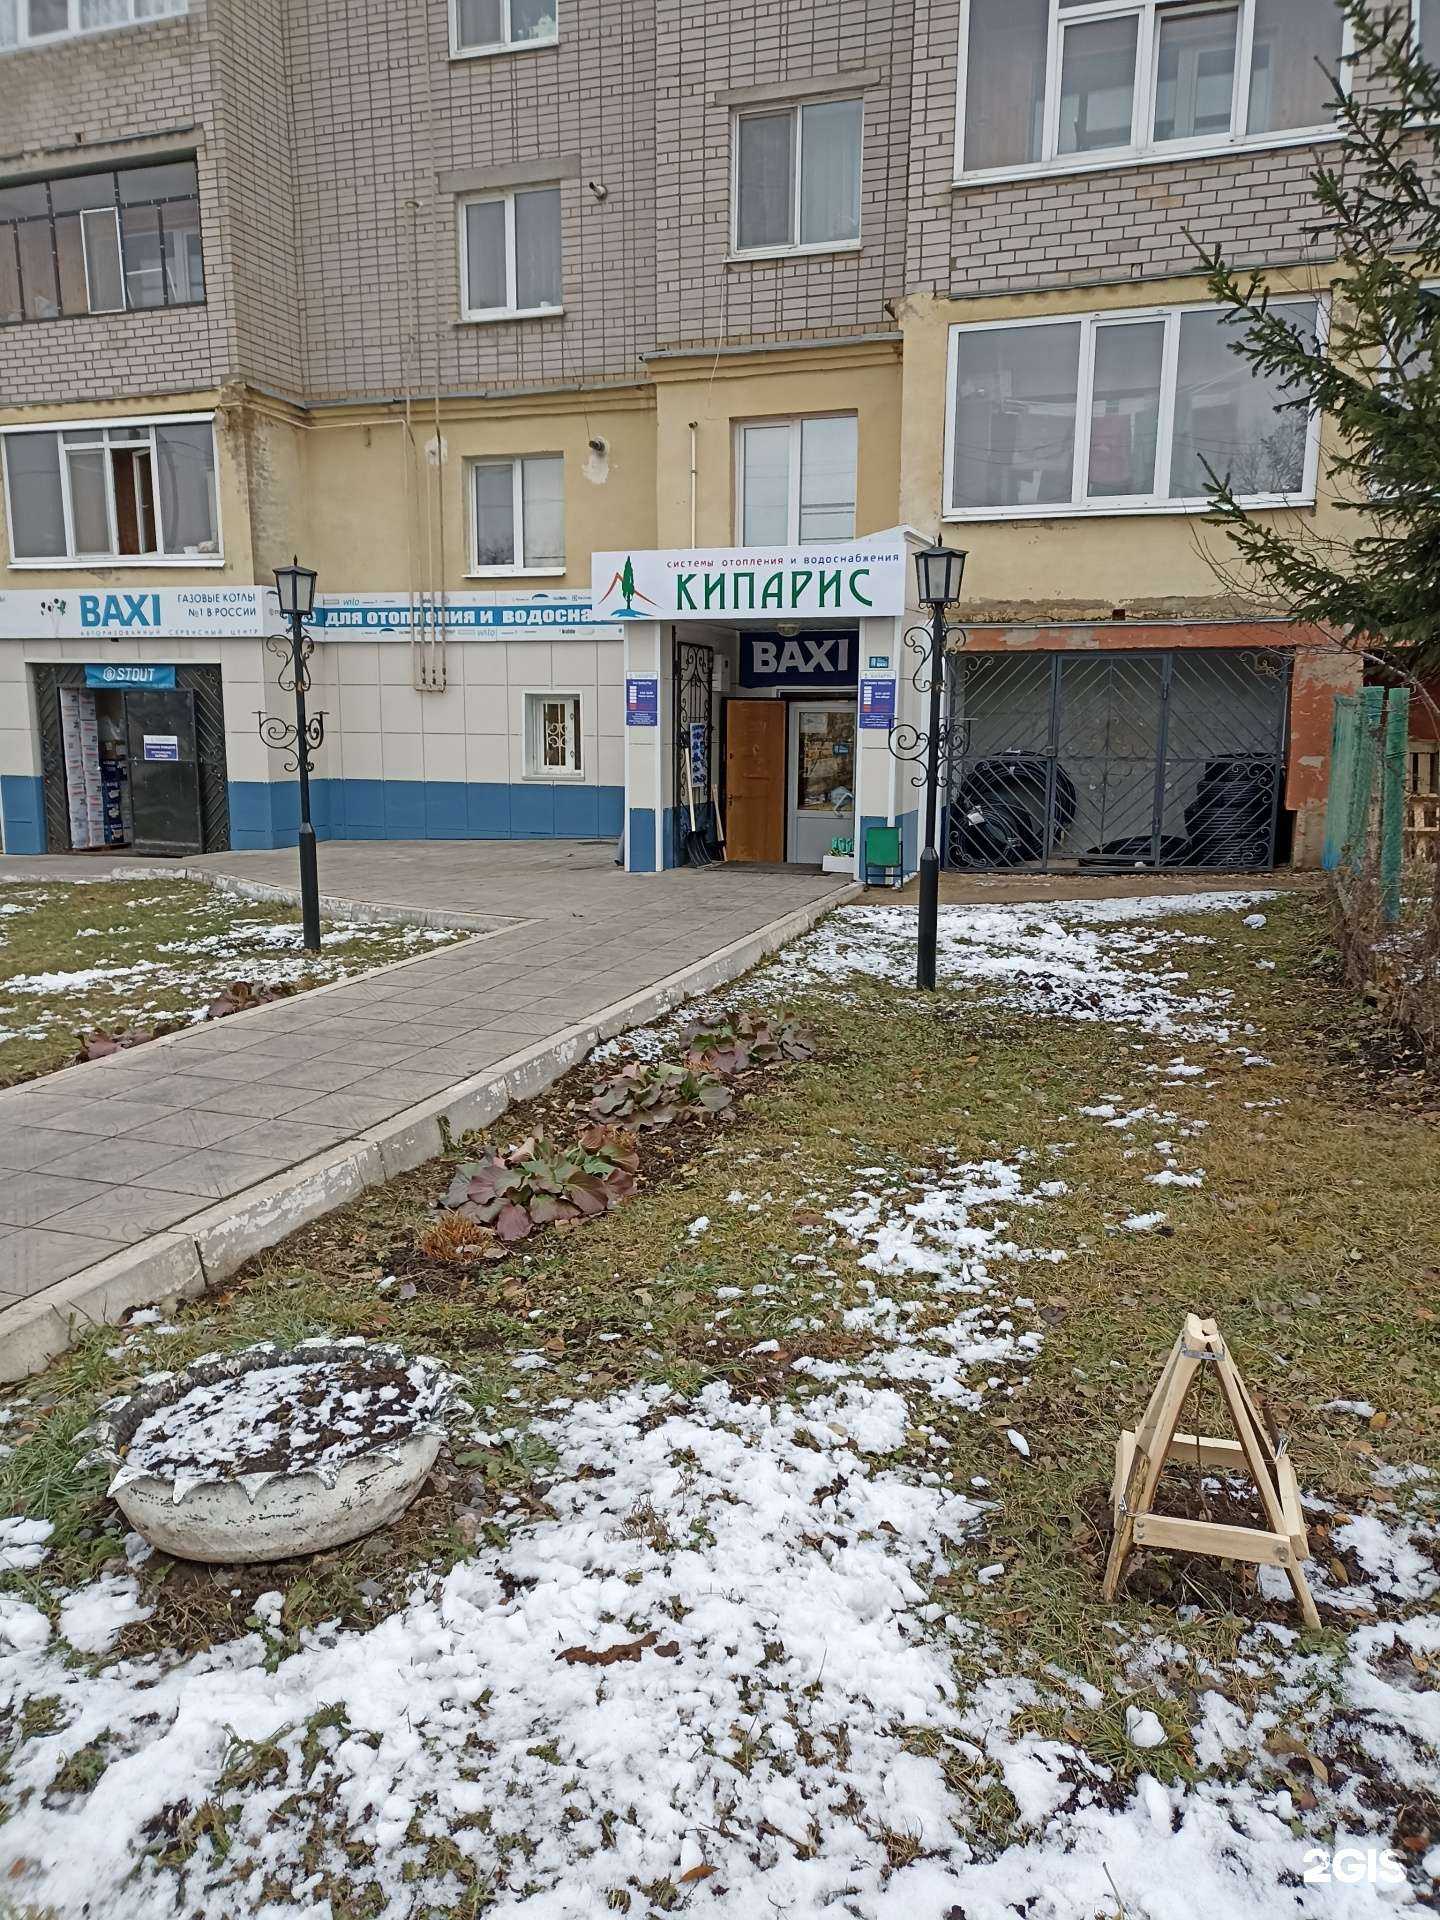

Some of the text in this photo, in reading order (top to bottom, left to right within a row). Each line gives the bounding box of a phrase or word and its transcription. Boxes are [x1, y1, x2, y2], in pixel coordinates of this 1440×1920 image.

[666, 560, 713, 568] системы
[722, 557, 784, 567] отопления
[803, 553, 899, 565] водоснабжения
[677, 568, 873, 610] КИПАРИС
[177, 592, 256, 603] ГАЗОВЫЕ КОТЛЫ
[79, 594, 161, 627] BAXI
[207, 608, 212, 616] В
[215, 607, 256, 617] РОССИИ
[751, 638, 849, 674] BAXI
[116, 667, 155, 682] STOUT
